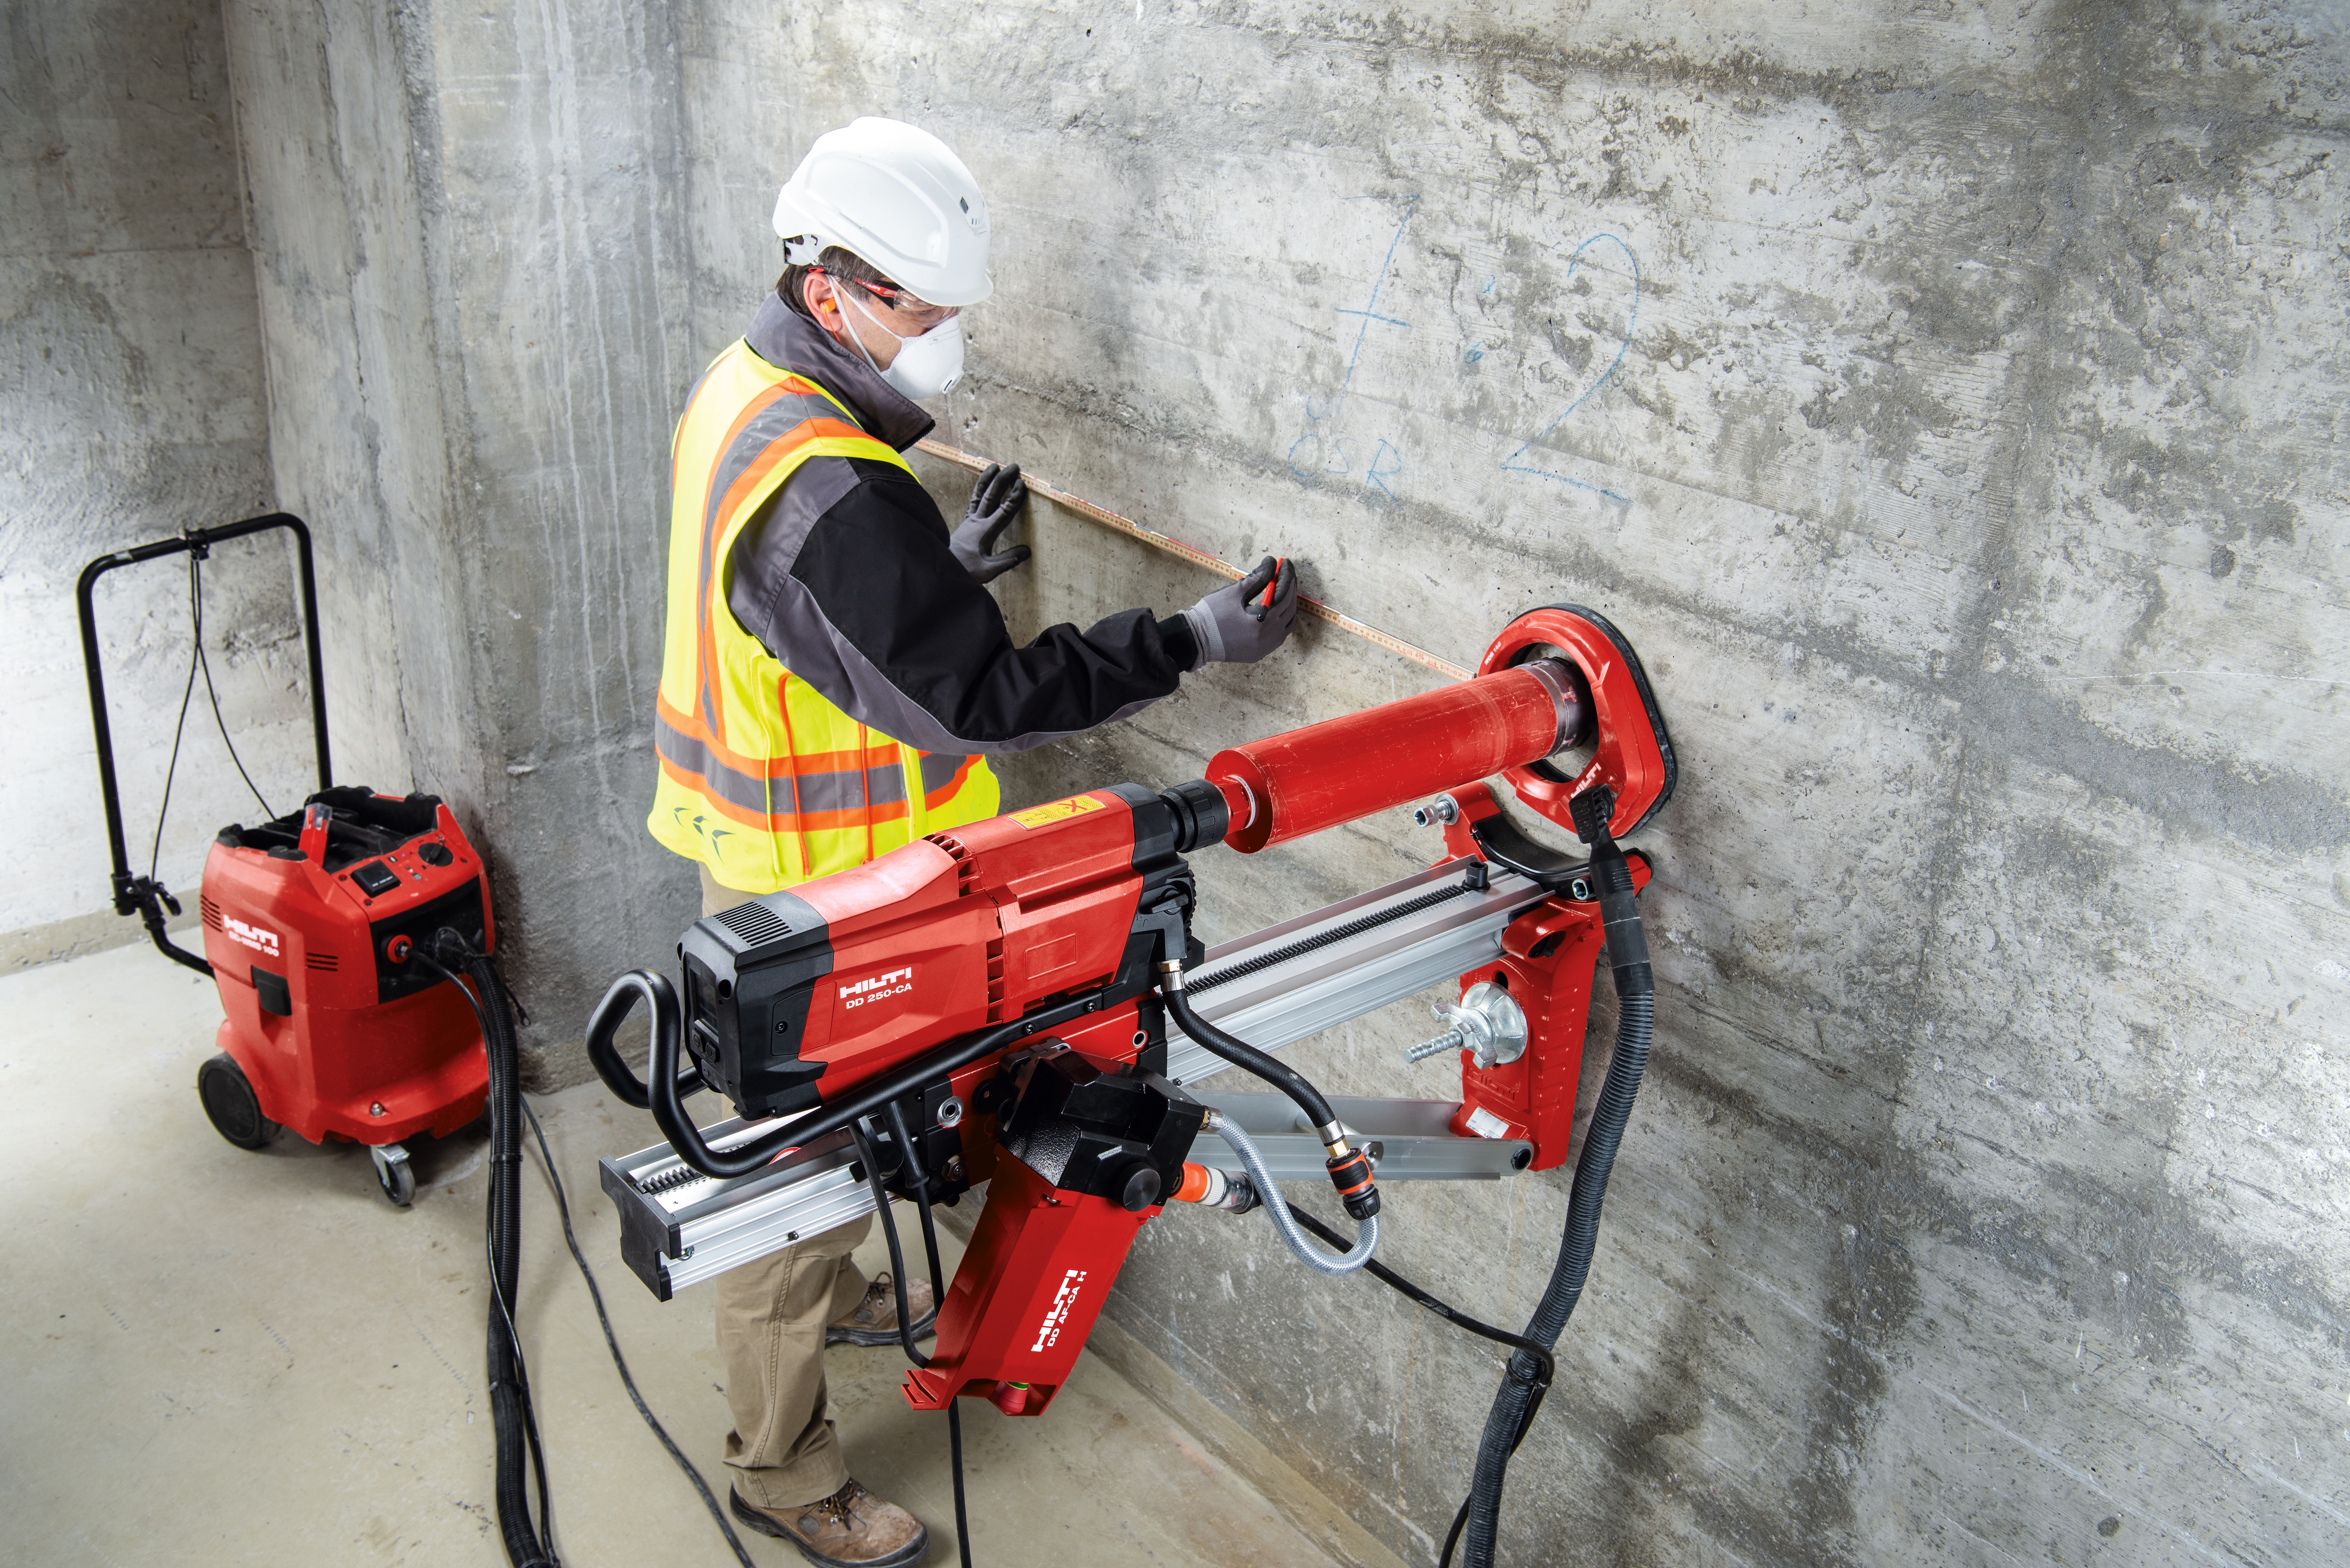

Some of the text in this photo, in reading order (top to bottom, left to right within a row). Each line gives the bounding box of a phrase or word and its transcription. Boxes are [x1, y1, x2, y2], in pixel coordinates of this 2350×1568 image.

[223, 914, 278, 948] HILTI
[263, 945, 279, 957] 100
[840, 967, 911, 999] HILTI
[846, 983, 912, 1009] DD 250-CA
[1031, 1269, 1078, 1352] HILTI
[1047, 1271, 1087, 1347] DD AF-CA H
